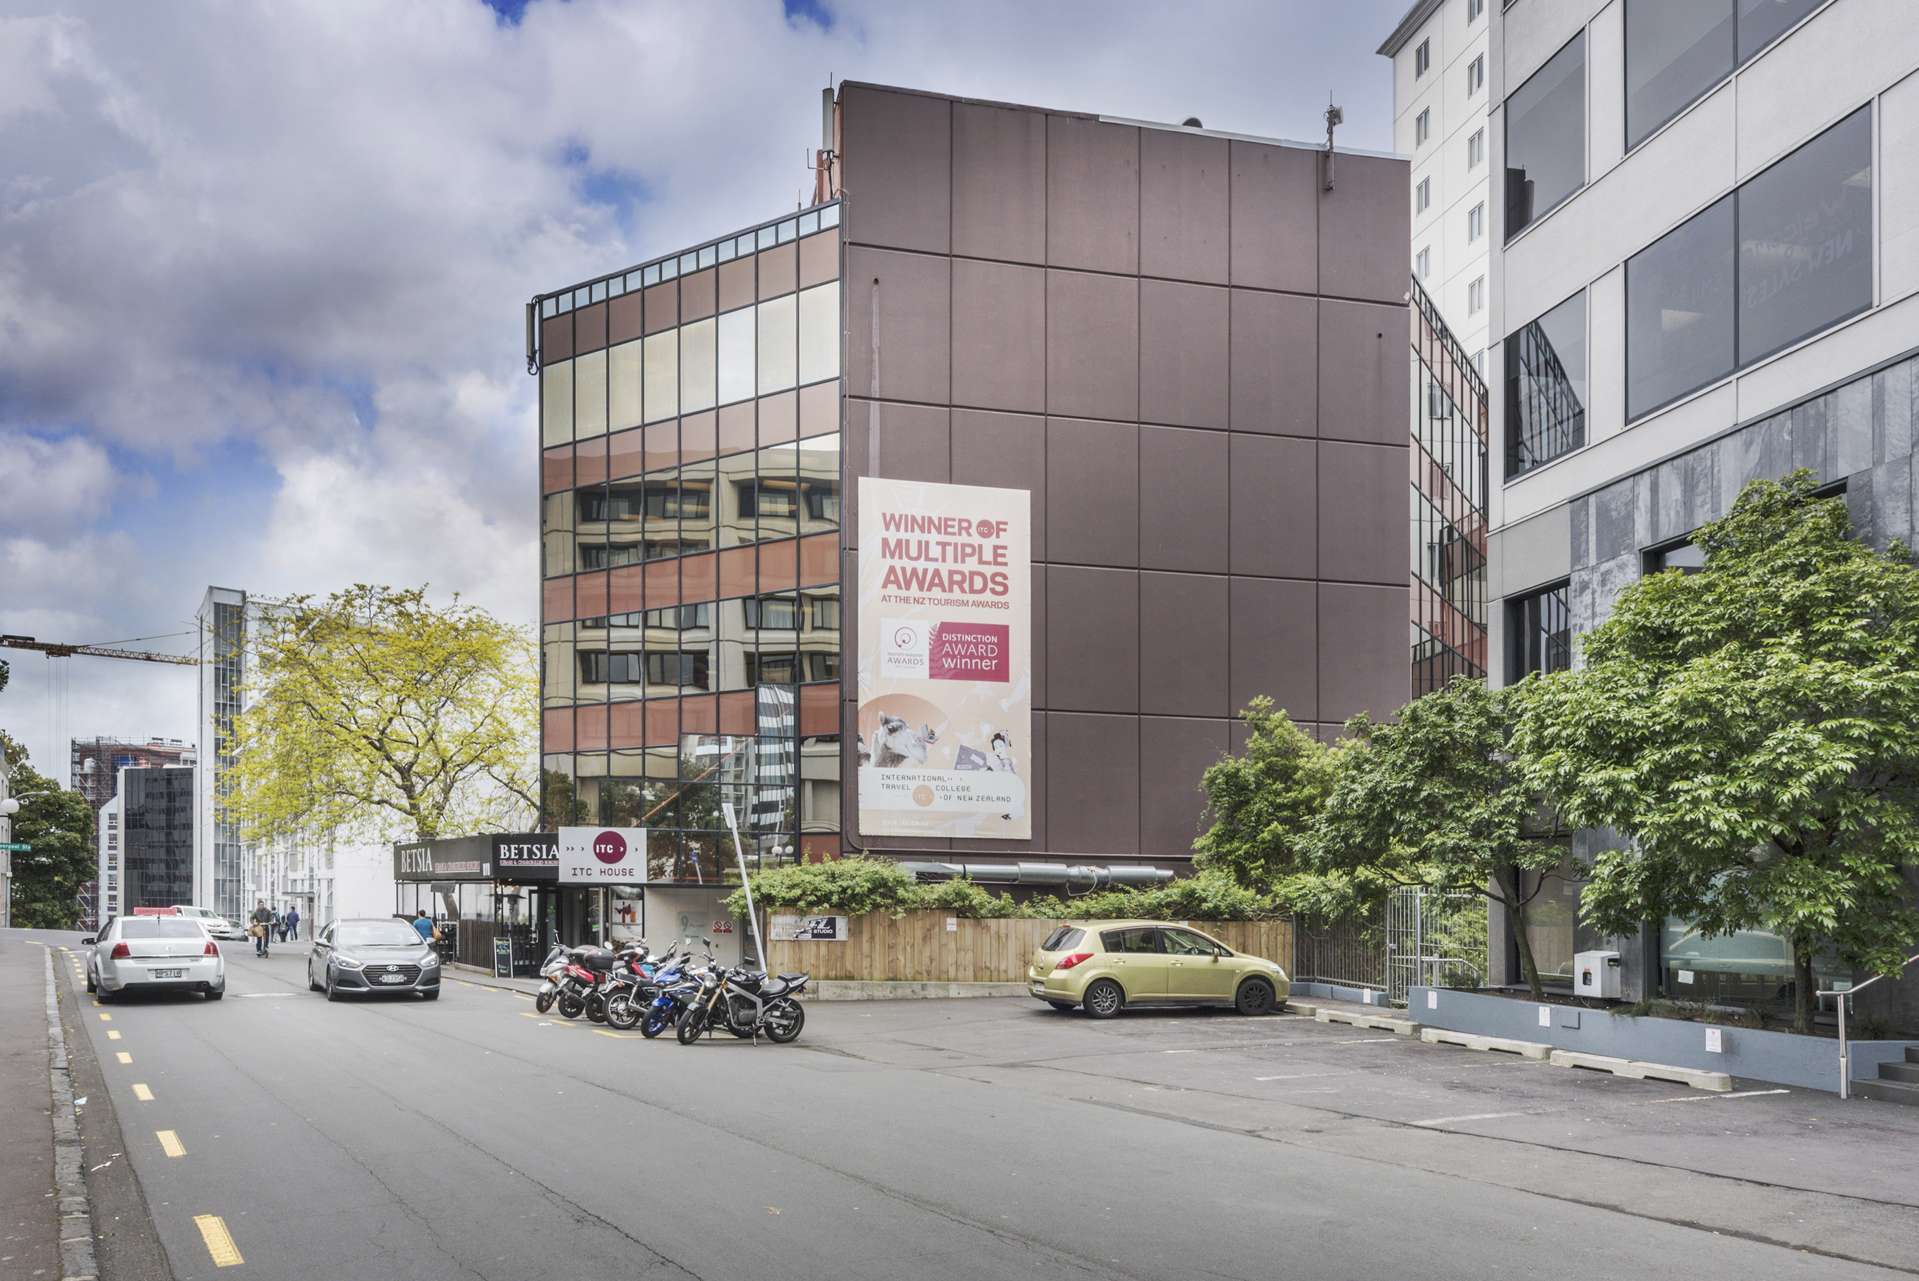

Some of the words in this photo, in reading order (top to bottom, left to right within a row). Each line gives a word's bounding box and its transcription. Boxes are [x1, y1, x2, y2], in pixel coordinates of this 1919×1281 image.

[881, 512, 972, 537] WINNER
[881, 537, 1009, 567] MULTIPLE
[881, 565, 1009, 596] AWARDS
[881, 594, 893, 603] AT
[894, 595, 912, 604] THE
[913, 597, 926, 605] NZ
[928, 597, 970, 608] TOURISM
[970, 600, 1009, 609] AWARDS
[942, 633, 997, 643] DISTINCTION
[942, 643, 998, 656] AWARD
[942, 656, 998, 671] winner
[881, 774, 947, 782] INTERNATIONAL
[881, 783, 912, 791] TRAVEL
[975, 795, 1011, 803] ZEALAND
[499, 844, 559, 860] BETSIA
[595, 844, 614, 853] ITC
[401, 847, 433, 873] BETSIA
[571, 867, 592, 877] ITC
[600, 868, 635, 877] HOUSE
